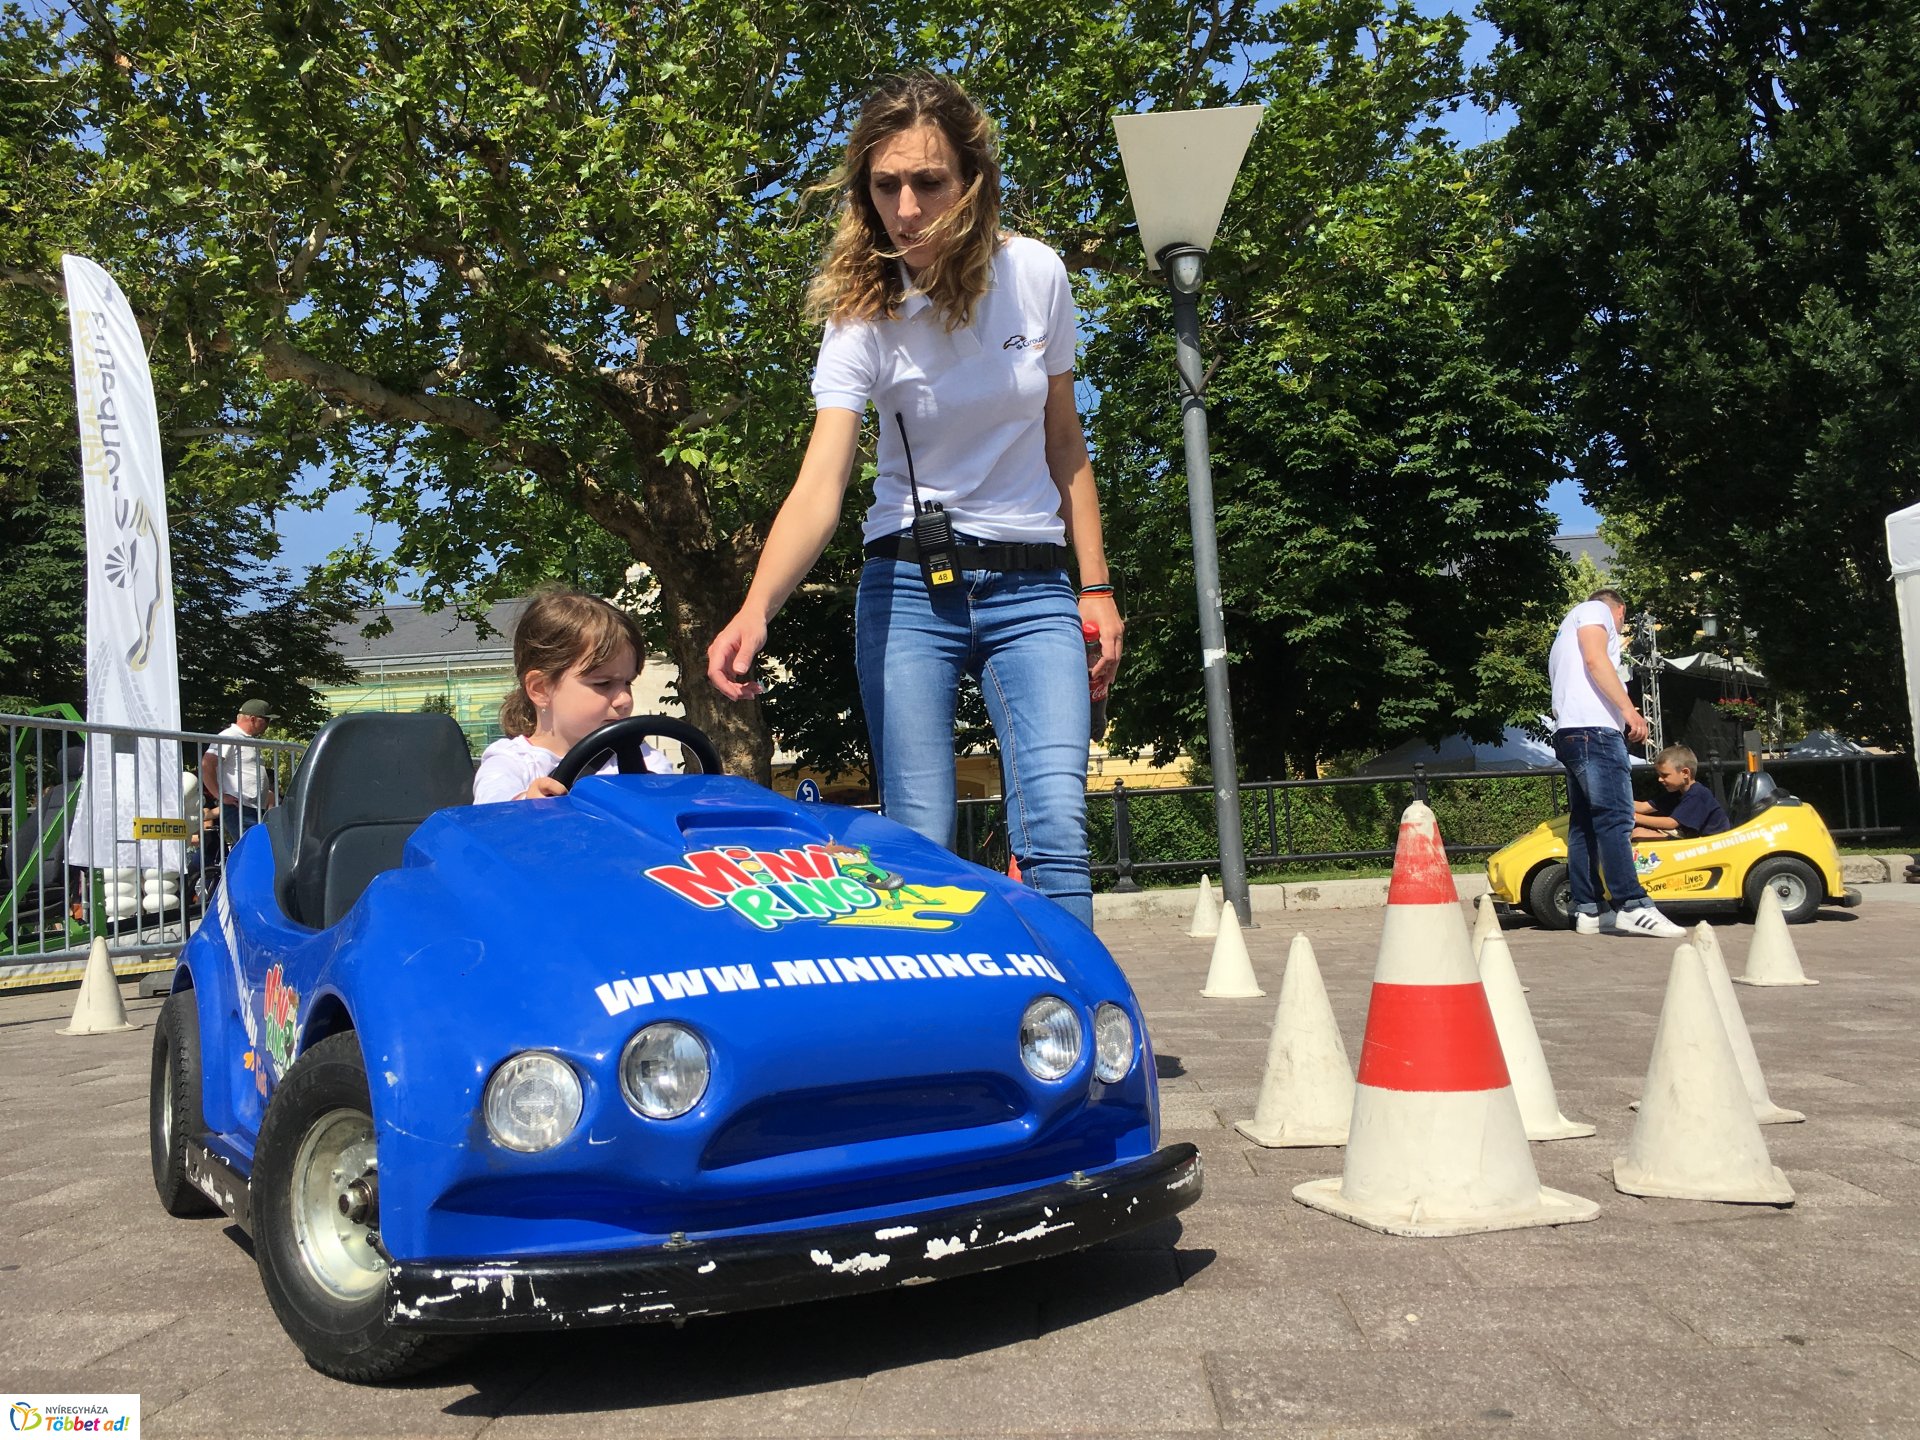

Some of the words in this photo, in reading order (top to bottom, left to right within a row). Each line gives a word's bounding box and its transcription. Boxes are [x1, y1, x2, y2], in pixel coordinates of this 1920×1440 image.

[938, 573, 948, 581] 48
[142, 822, 187, 836] profirent
[726, 875, 878, 929] RING
[595, 952, 1067, 1016] WWW.MINIRING.HU
[266, 1012, 286, 1065] RING
